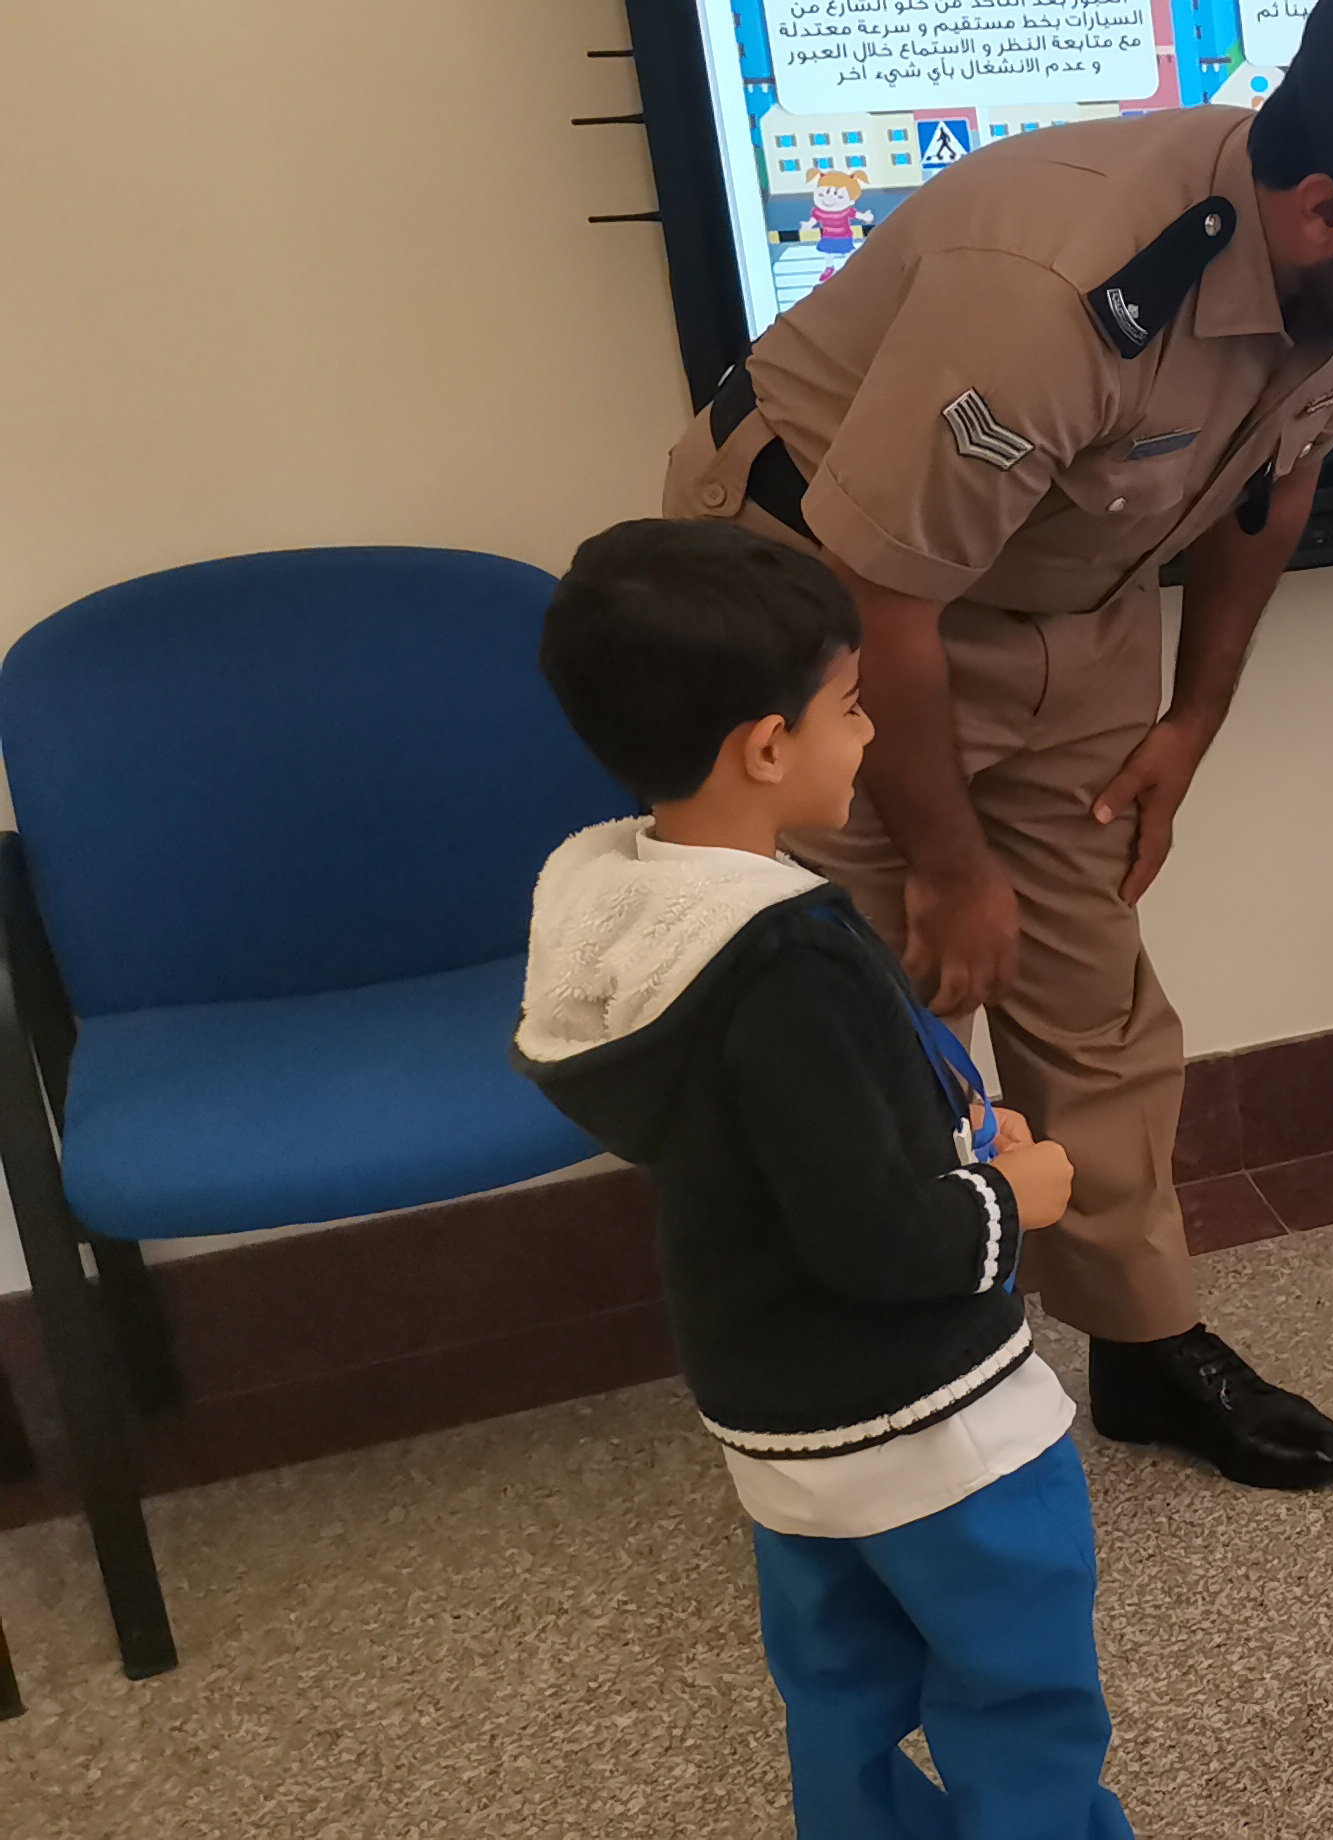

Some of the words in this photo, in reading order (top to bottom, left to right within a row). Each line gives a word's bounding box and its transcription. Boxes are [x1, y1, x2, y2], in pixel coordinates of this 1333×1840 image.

[1065, 9, 1144, 31] السيارات
[1257, 2, 1279, 22] ثم
[779, 21, 852, 37] معتدلة
[857, 19, 911, 38] سرعة
[917, 22, 928, 36] و
[933, 15, 1016, 36] مستقيم
[1022, 14, 1061, 31] بخط
[852, 41, 893, 63] خلال
[899, 37, 975, 59] الاستماع
[982, 42, 992, 57] و
[997, 34, 1046, 57] النظر
[1051, 33, 1113, 52] متابعة
[1118, 34, 1141, 51] مع
[788, 43, 848, 65] العبور
[875, 61, 921, 88] شيء
[927, 57, 955, 86] بأي
[960, 57, 1040, 80] الانشغال
[1045, 60, 1086, 78] عدم
[1091, 61, 1101, 75] و
